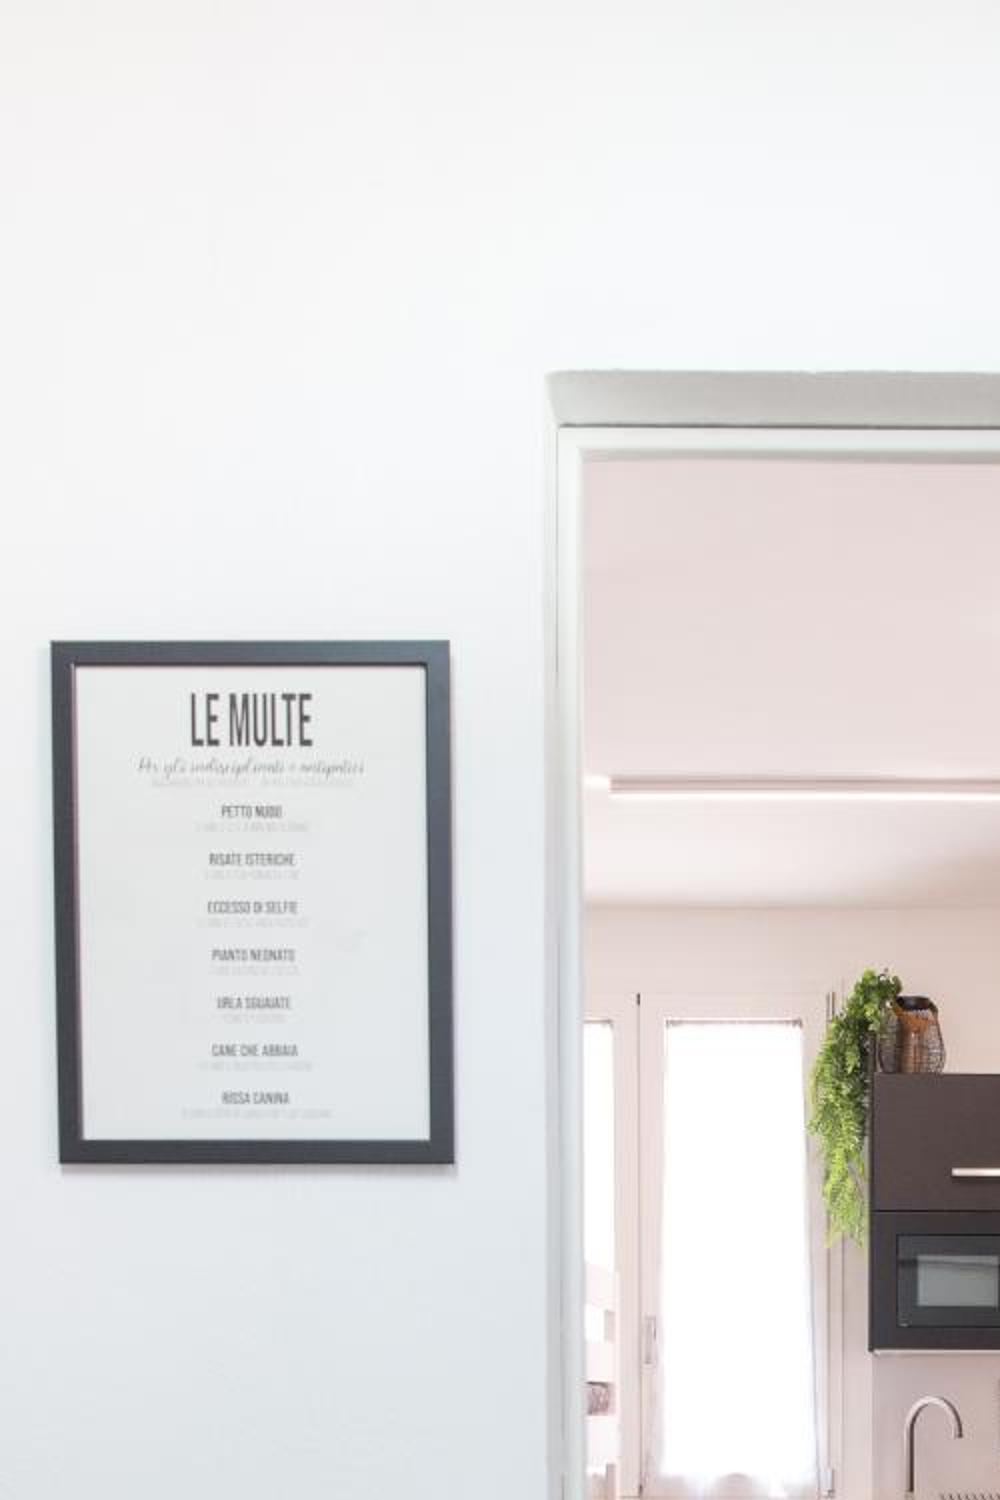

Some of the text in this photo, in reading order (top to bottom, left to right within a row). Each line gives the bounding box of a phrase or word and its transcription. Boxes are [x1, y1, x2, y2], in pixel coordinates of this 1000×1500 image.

[190, 692, 313, 747] LE MULTE
[221, 804, 283, 819] PETTO NUDO
[208, 852, 295, 867] RISATE ISTERICHE
[207, 900, 299, 915] ECCESSO DI SELFIE
[211, 948, 296, 962] PIANTO NEONATO
[211, 1043, 299, 1057] CANE CHE ABBAIA
